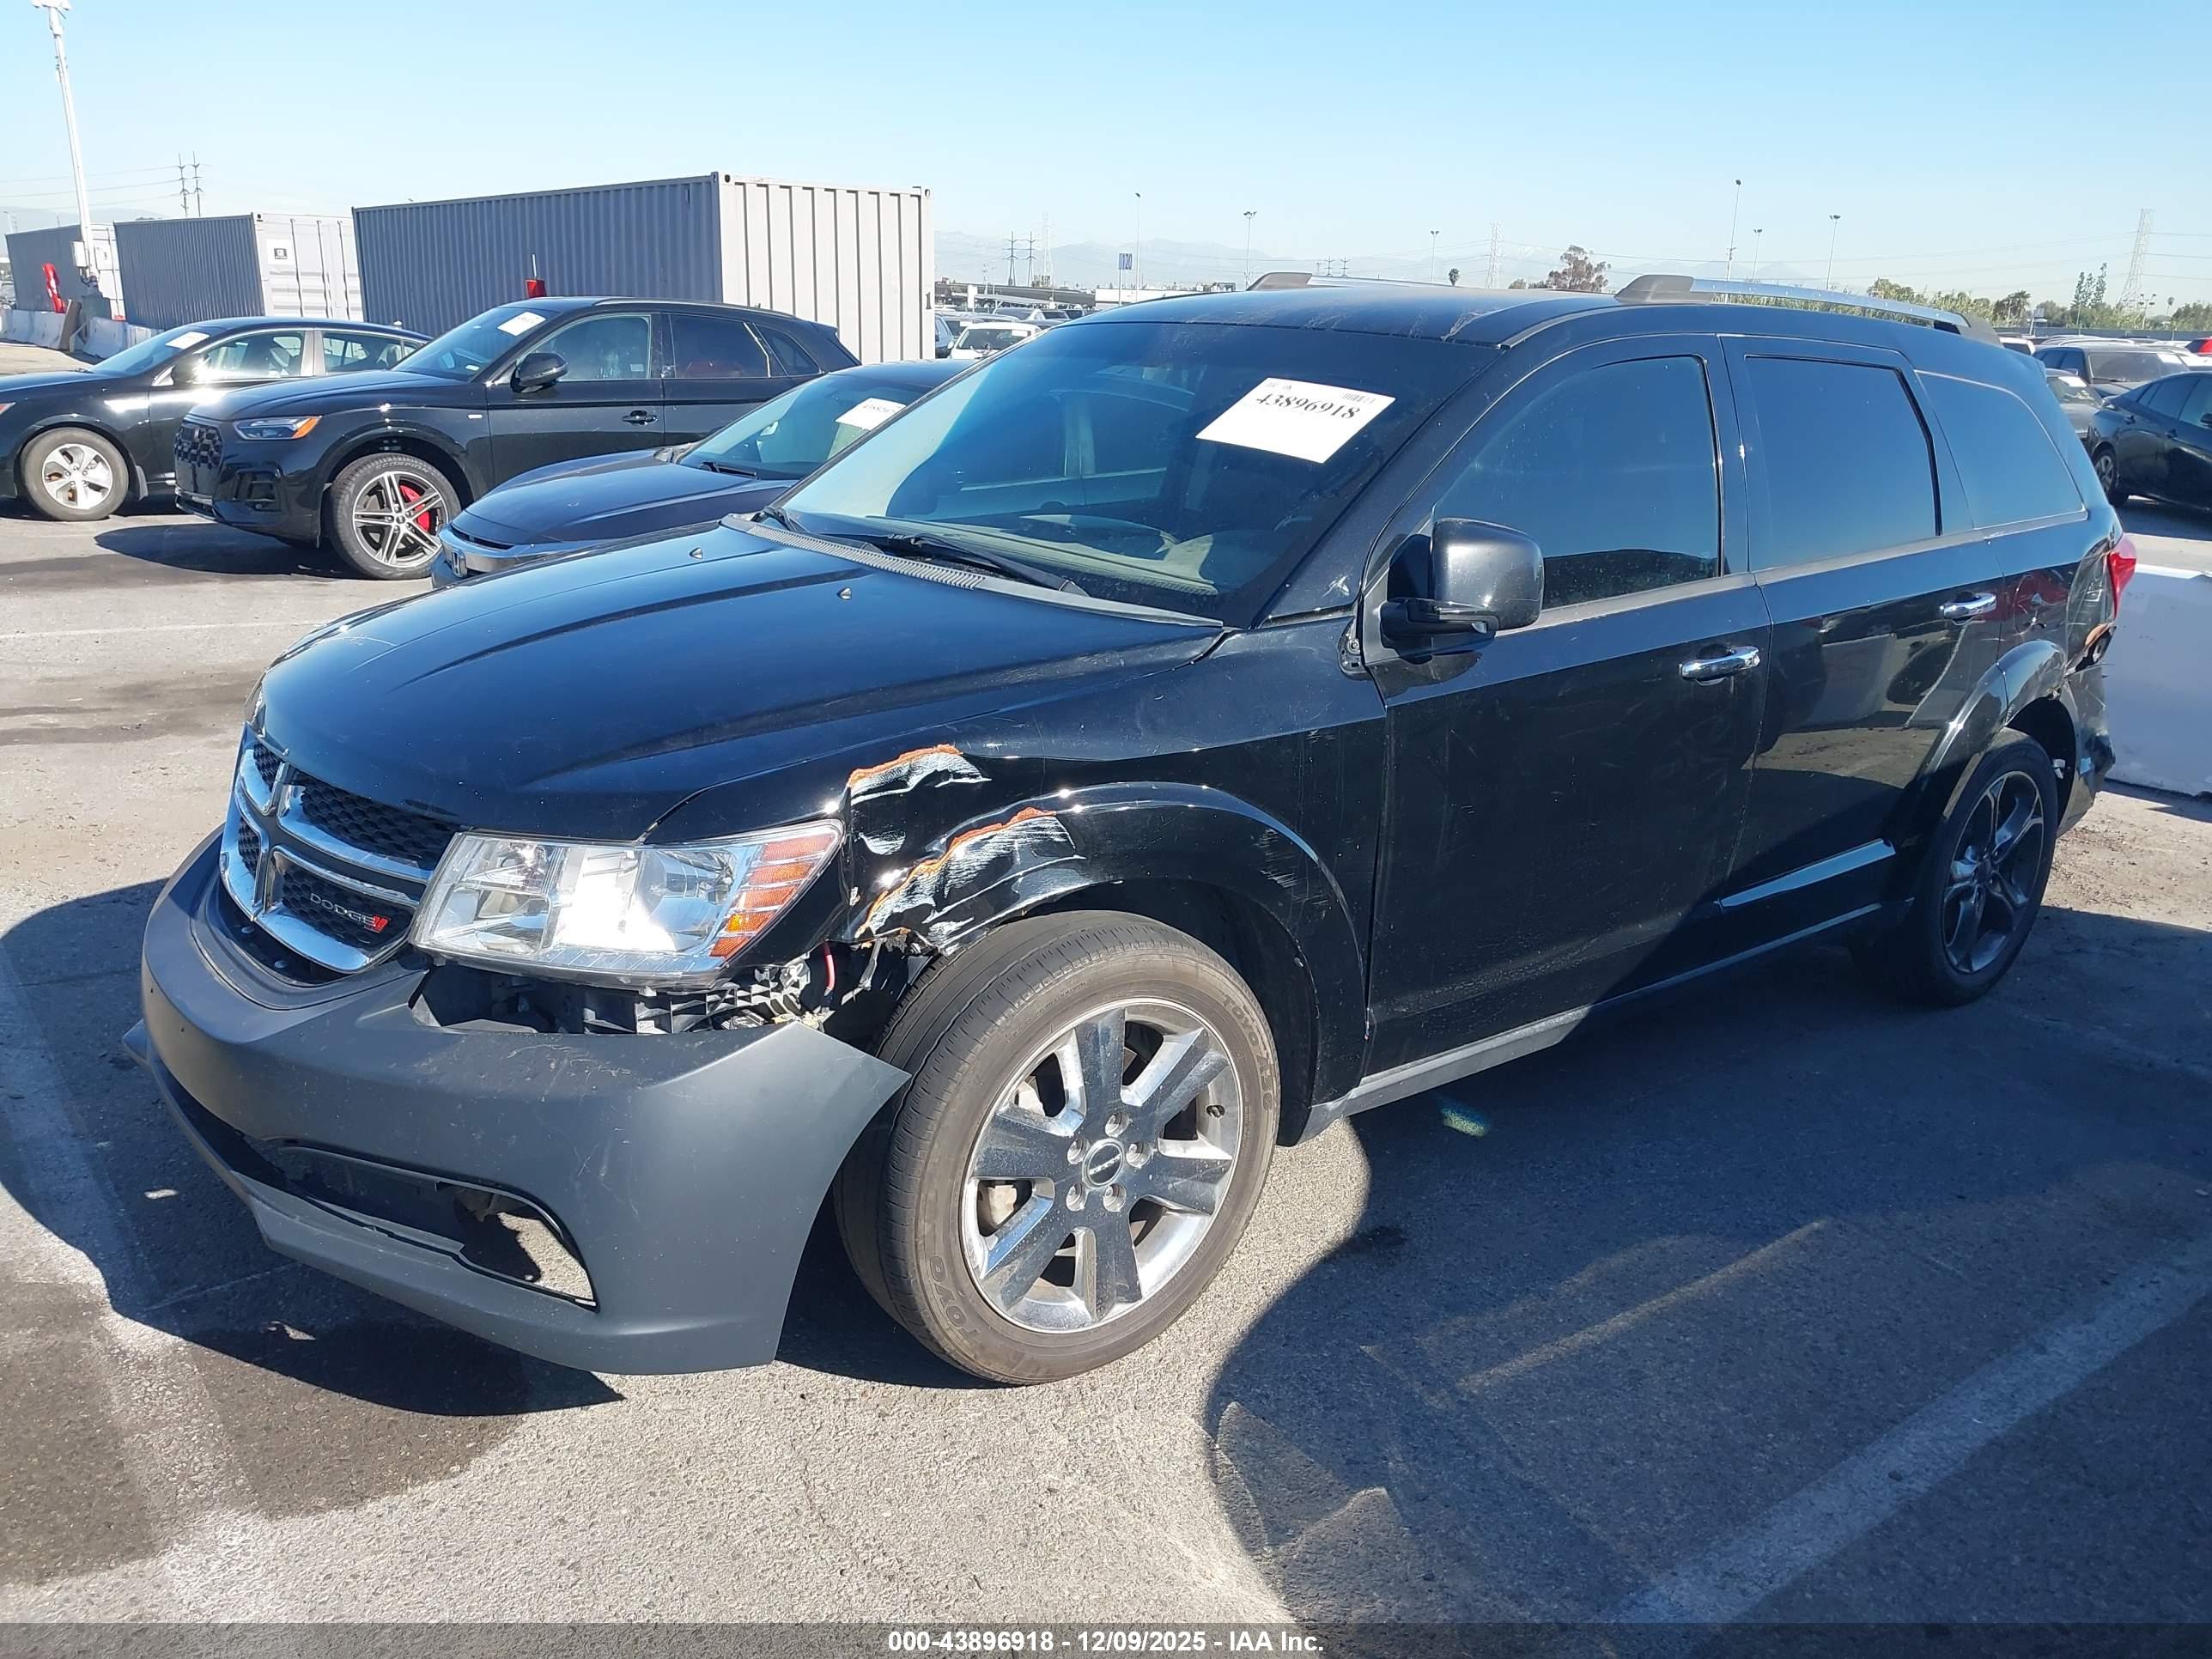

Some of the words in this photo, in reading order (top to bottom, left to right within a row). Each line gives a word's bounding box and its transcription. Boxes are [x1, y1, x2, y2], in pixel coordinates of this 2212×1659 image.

[1256, 392, 1361, 419] 43896918
[375, 460, 430, 474] SCORPION
[309, 892, 376, 927] DODGE
[1221, 993, 1260, 1048] TOYO
[930, 1255, 981, 1346] TOYO
